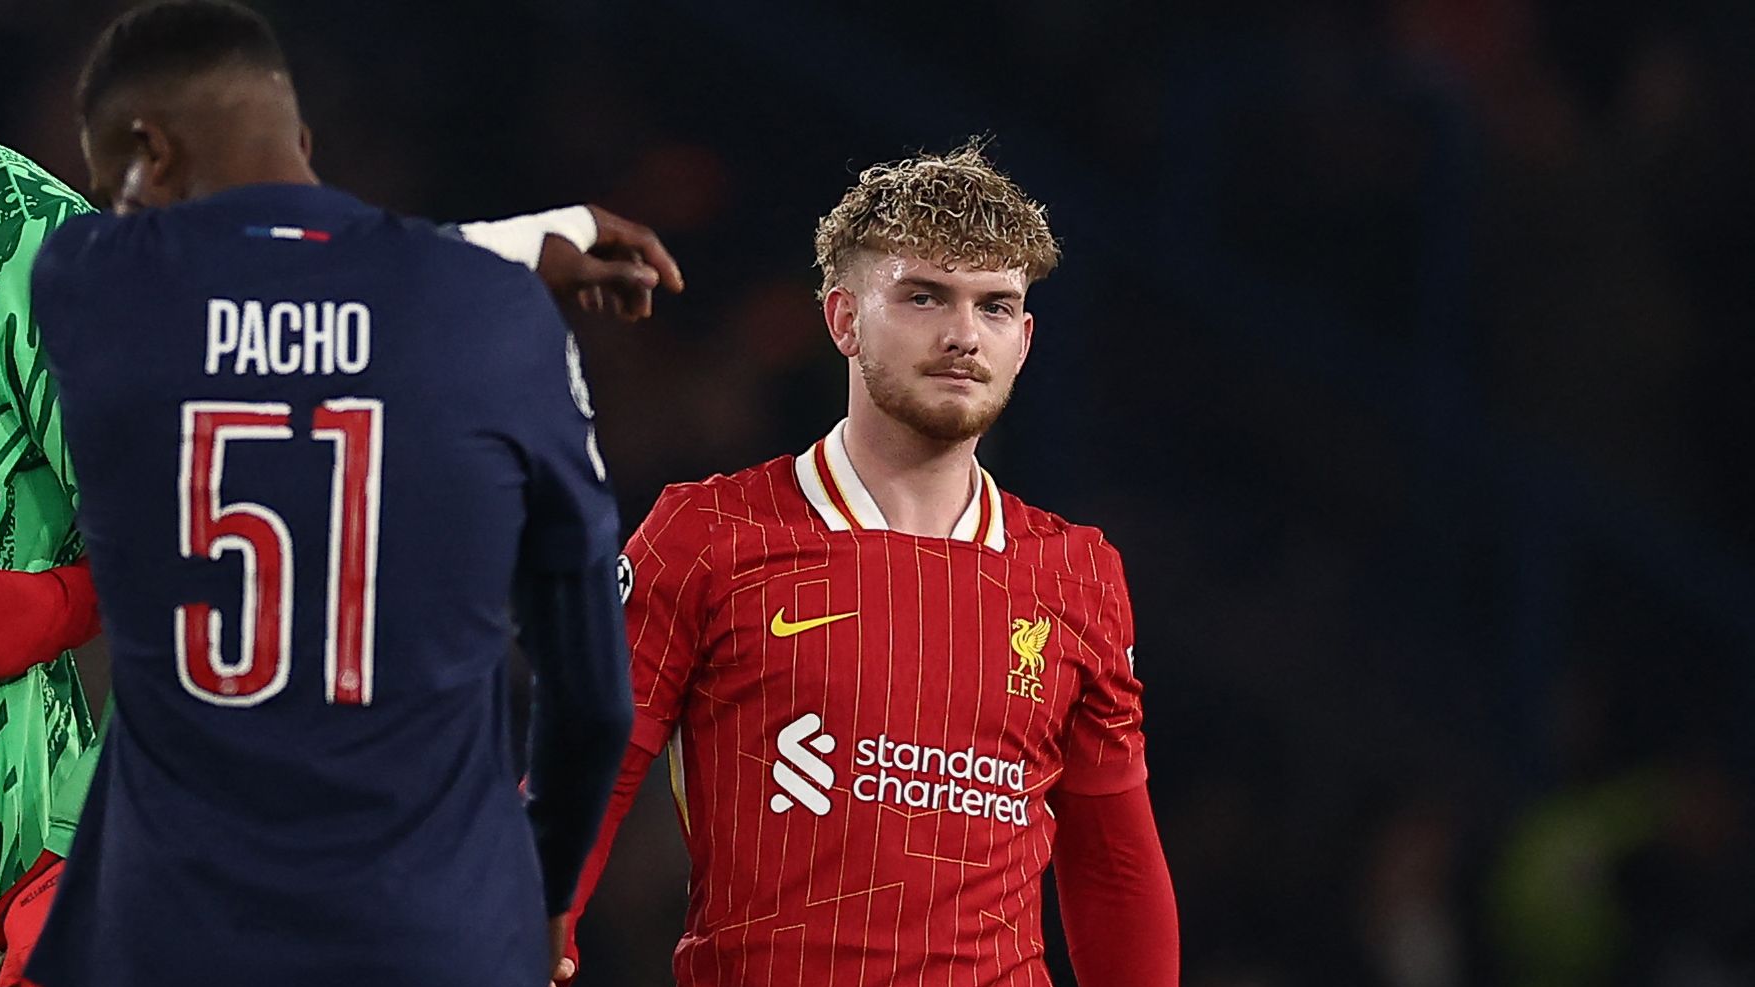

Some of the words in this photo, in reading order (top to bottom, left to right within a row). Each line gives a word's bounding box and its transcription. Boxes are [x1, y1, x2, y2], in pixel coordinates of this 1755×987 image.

[205, 298, 372, 375] PACHO
[174, 397, 384, 708] 51
[855, 734, 1026, 791] standard
[852, 768, 1029, 826] chartered
